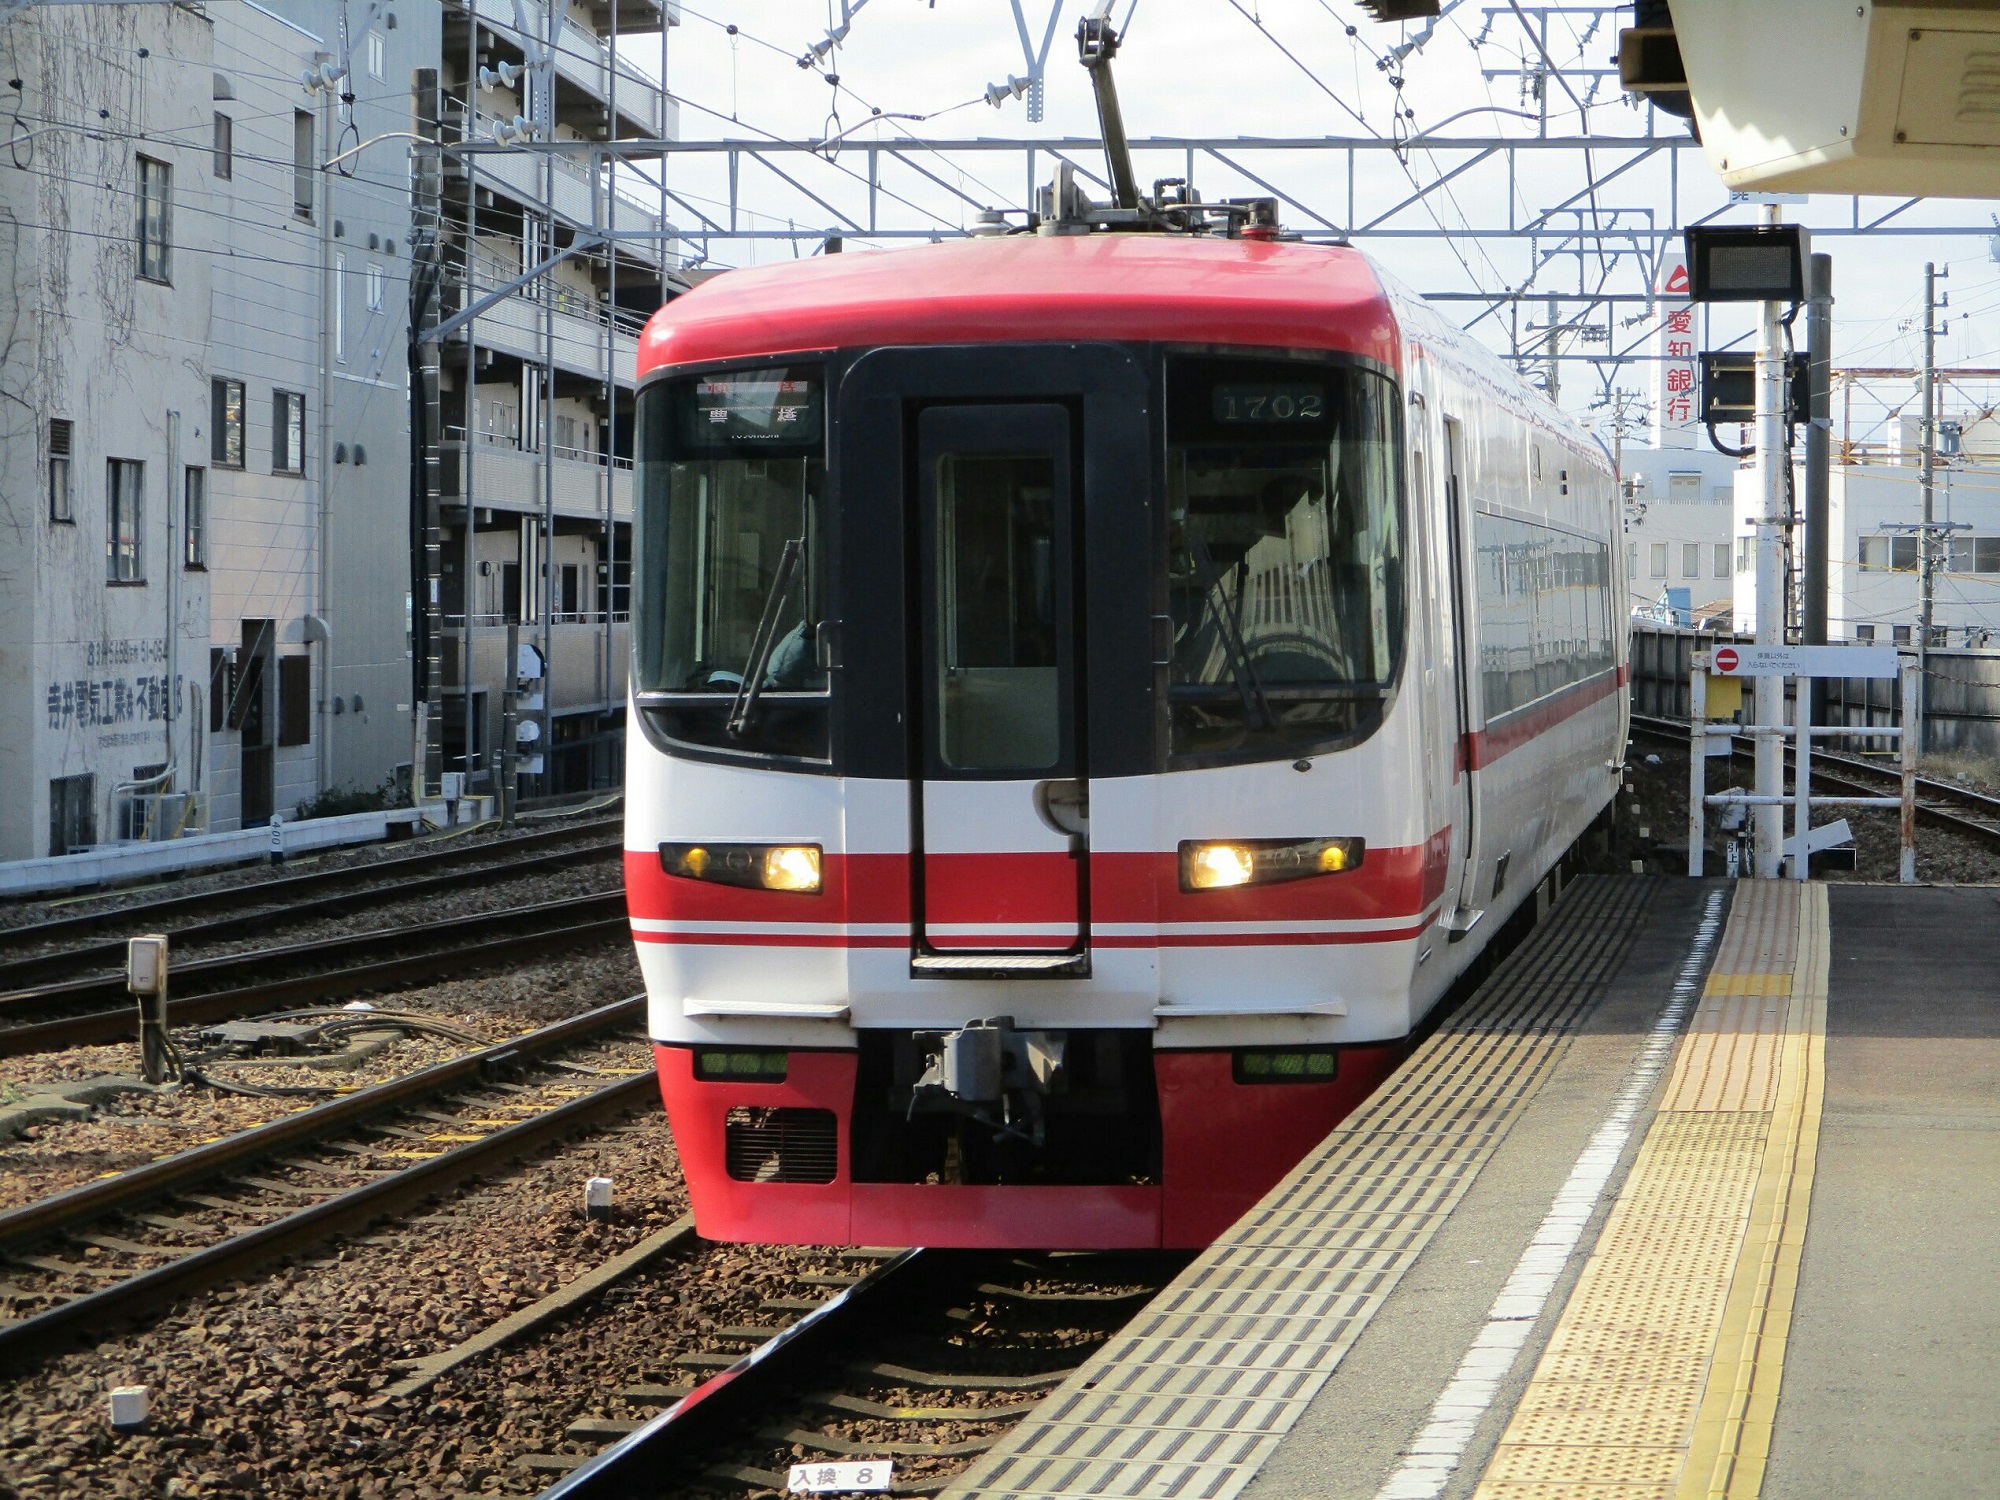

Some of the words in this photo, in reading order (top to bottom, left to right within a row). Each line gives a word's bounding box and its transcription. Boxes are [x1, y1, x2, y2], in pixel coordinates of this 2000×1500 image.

[1667, 310, 1691, 421] 愛知銀行
[1224, 395, 1321, 418] 1702
[1757, 652, 1789, 660] 係員以外は
[272, 821, 281, 845] 400
[793, 1467, 837, 1486] 入換
[856, 1467, 874, 1485] 8
